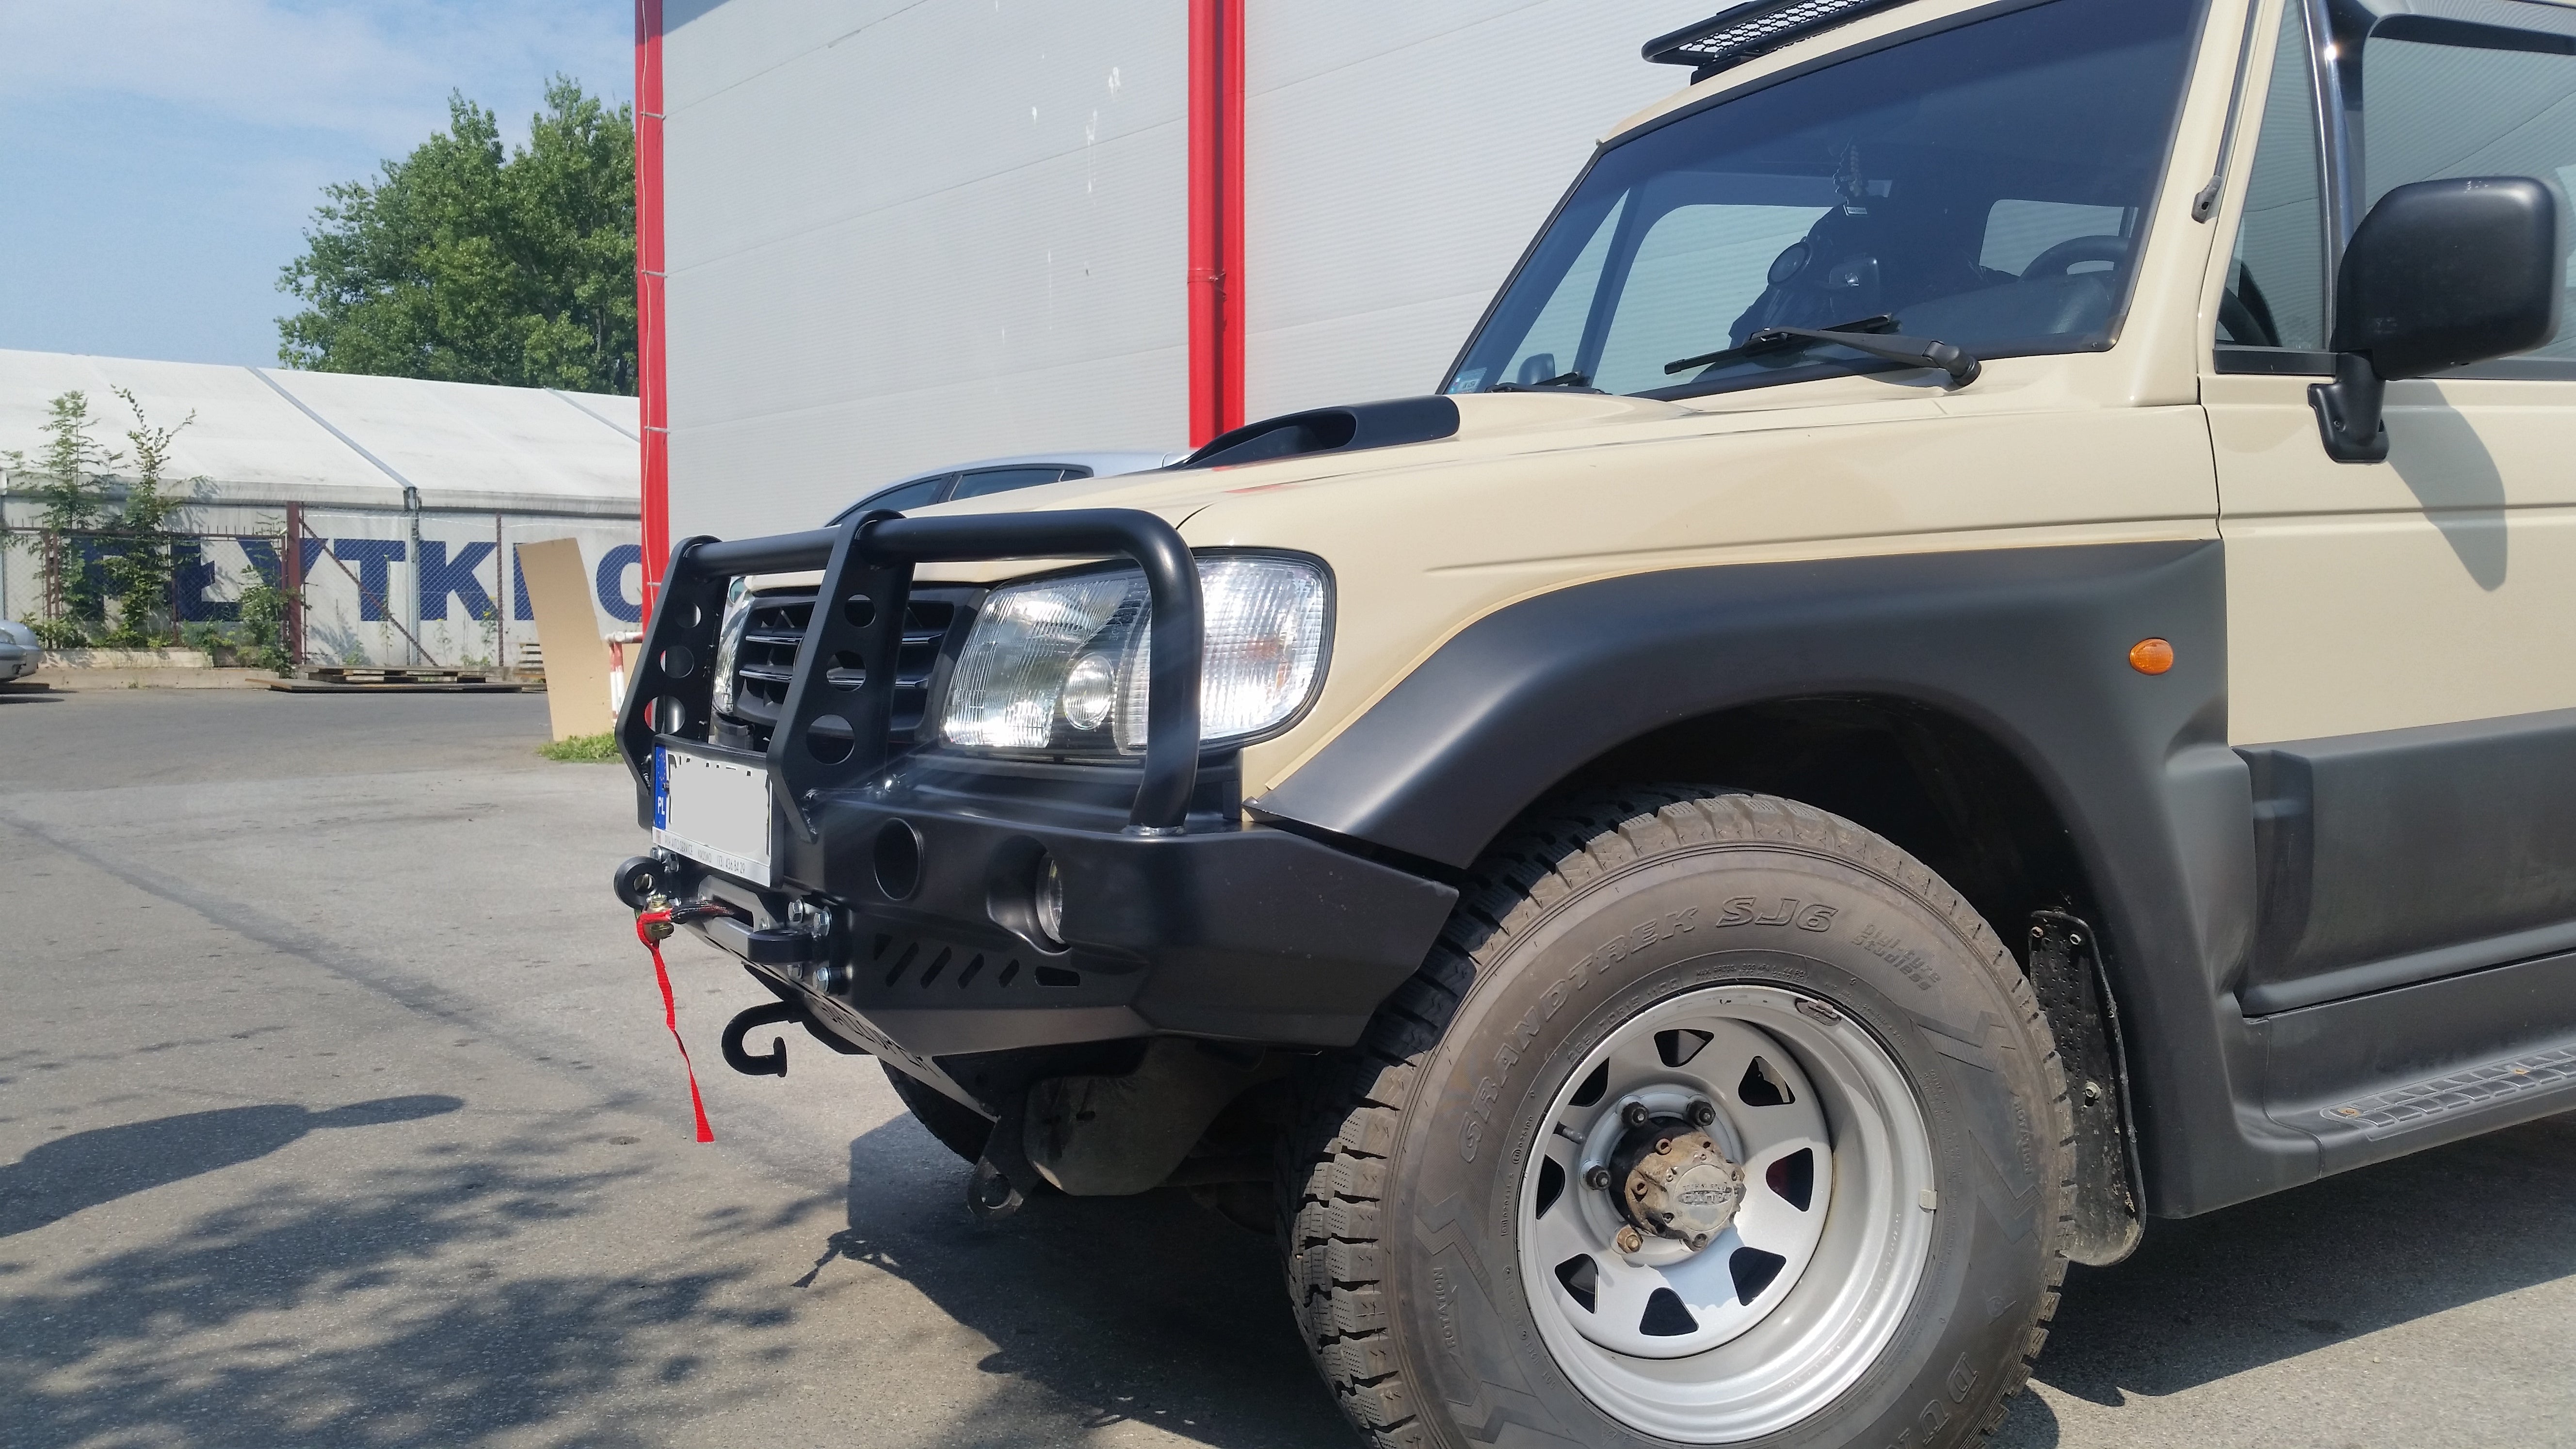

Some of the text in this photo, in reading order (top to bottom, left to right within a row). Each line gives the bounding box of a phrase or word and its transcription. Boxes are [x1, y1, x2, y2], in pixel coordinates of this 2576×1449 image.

[657, 796, 665, 815] PL
[1852, 934, 1932, 990] Studless
[1460, 896, 1839, 1163] GRANDTREK SJ6
[2014, 1100, 2033, 1175] ROTATION
[1433, 1267, 1456, 1350] ROTATION
